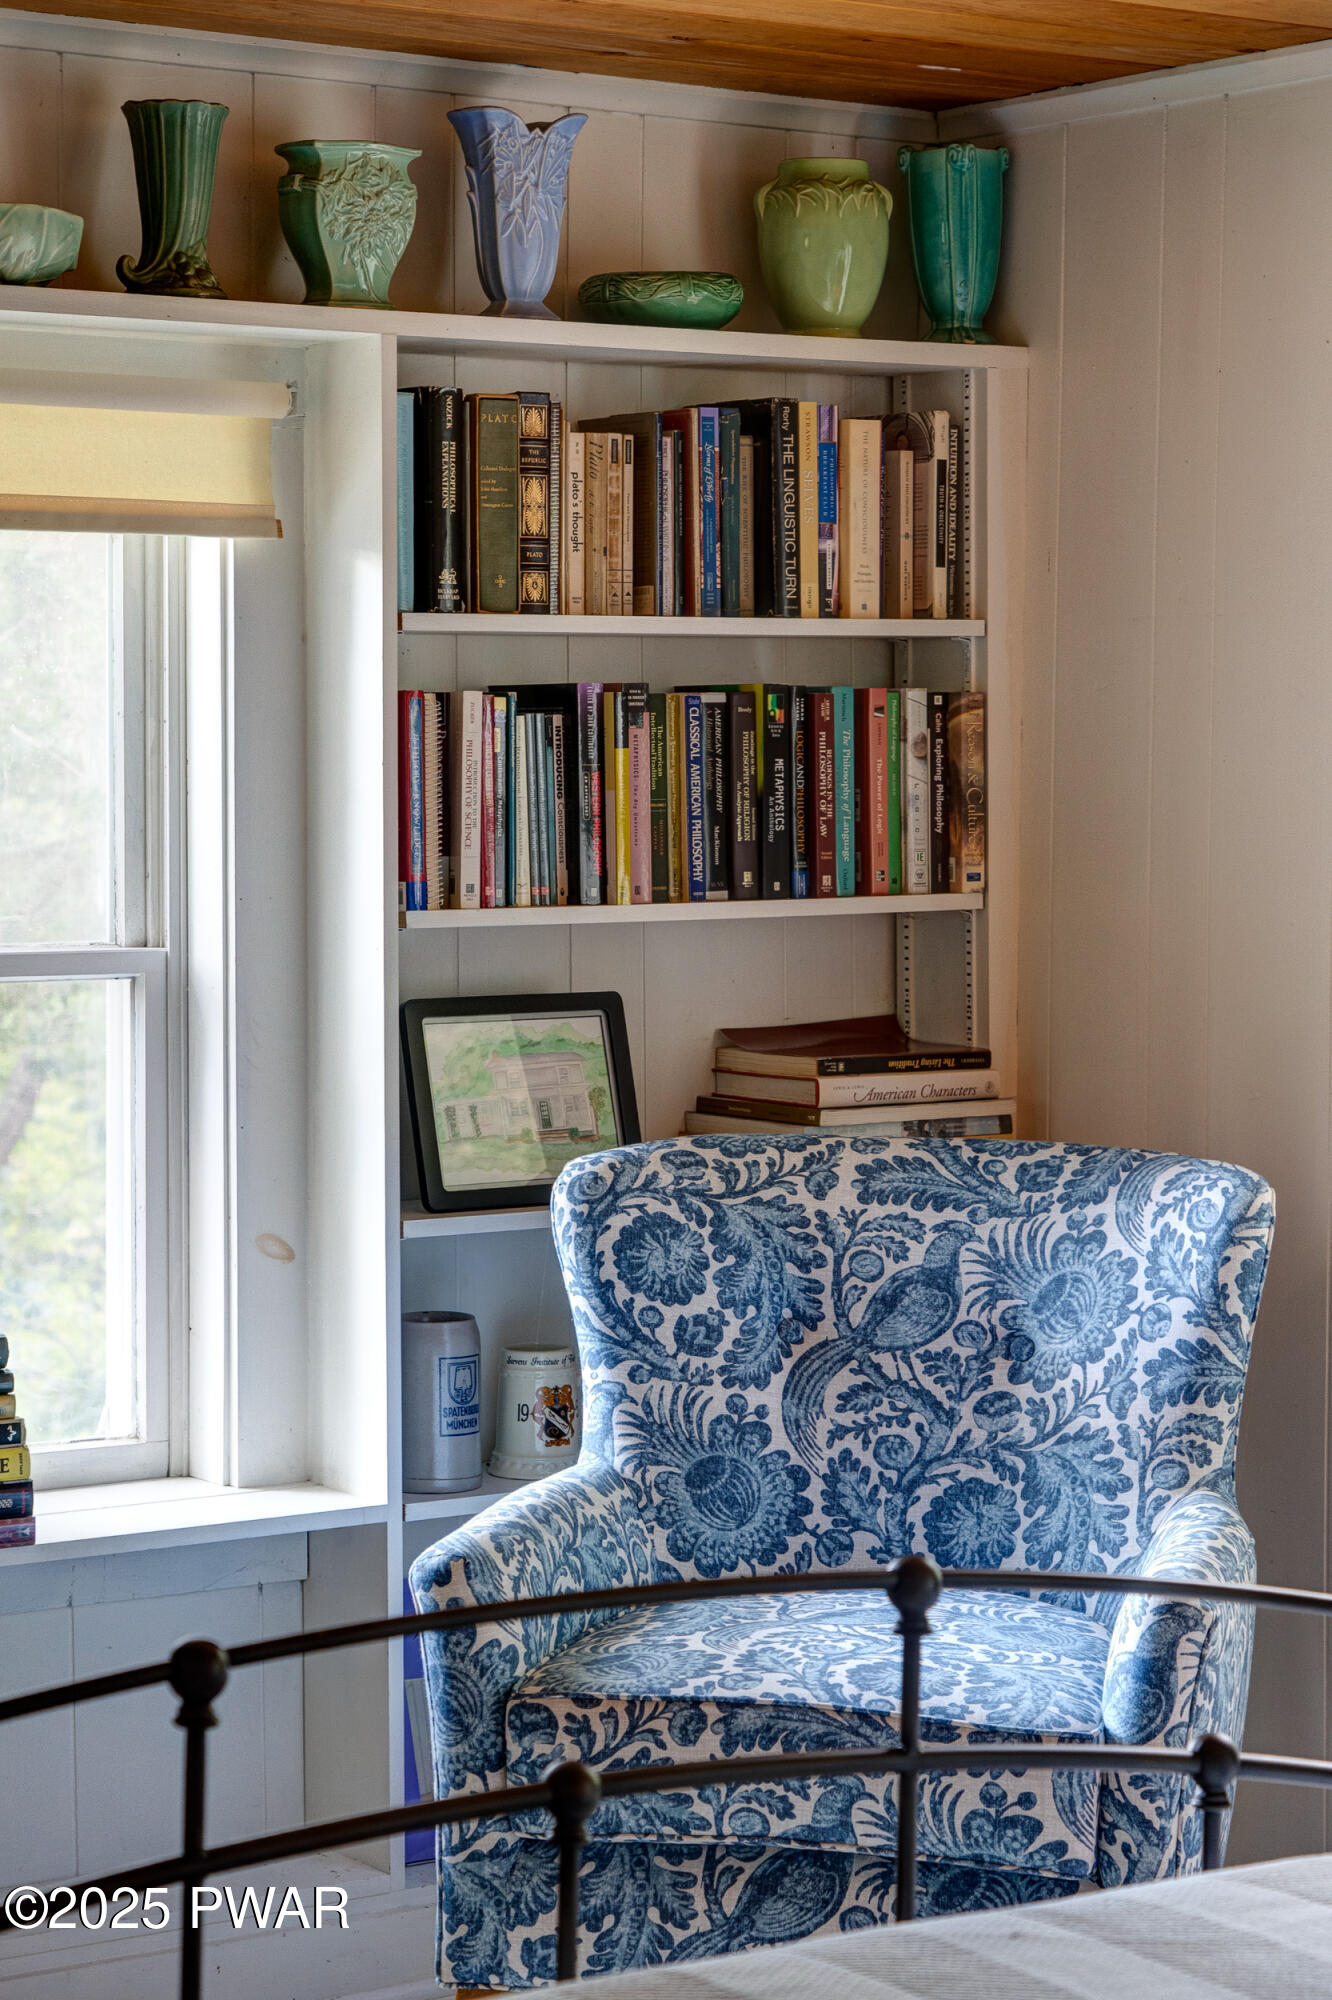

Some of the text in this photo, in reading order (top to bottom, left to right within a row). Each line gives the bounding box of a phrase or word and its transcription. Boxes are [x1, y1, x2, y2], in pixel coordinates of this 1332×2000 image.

[444, 395, 454, 429] NOZICK
[441, 440, 450, 509] EXPLANATIONS
[588, 440, 604, 480] Plato
[704, 442, 714, 467] Norms
[704, 466, 714, 474] of
[449, 440, 458, 515] PHILOSOPHICAL
[704, 476, 714, 503] Liberty
[804, 470, 815, 525] SELVES
[862, 479, 869, 489] OF
[948, 428, 958, 561] INTUITION AND IDEALITY
[570, 472, 583, 553] plato's thought
[742, 494, 749, 504] OF
[781, 406, 797, 599] Rorty THE LINGUISTIC TURN
[861, 491, 869, 555] CONSCIOUSNESS
[937, 510, 945, 544] OBJECTIVITY
[742, 552, 750, 598] PHILOSOPHY
[650, 712, 658, 791] Intellectual Tradition
[842, 729, 852, 747] The
[889, 736, 897, 762] Language
[706, 756, 714, 790] Anthology
[715, 757, 724, 813] PHILOSOPHY
[736, 781, 743, 790] An
[743, 731, 751, 841] PHILOSOPHY OF RELIGION
[818, 731, 828, 837] PHILOSOPHY OF LAW
[840, 749, 852, 801] Philosophy
[933, 712, 944, 833] Cahn Exploring Philosophy
[965, 721, 984, 845] Reason & Culture
[464, 739, 473, 850] PHILOSOPHY OF SCIENCE
[472, 807, 479, 816] TO
[496, 756, 504, 837] Contemporary Metaphysics
[555, 725, 566, 864] INTRODUCING Consciousness
[689, 707, 703, 882] CLASSICAL AMERICAN PHILOSOPHY
[774, 758, 785, 831] METAPHYSICS
[826, 790, 833, 799] IN
[840, 803, 852, 814] of
[876, 803, 883, 812] of
[412, 793, 421, 858] KNOWLEDGE
[591, 771, 602, 876] WESTERN PHILOSOPHY
[735, 814, 743, 842] Approach
[767, 796, 776, 843] An Anthology
[840, 815, 852, 862] Language
[875, 813, 883, 835] Logic
[888, 1059, 920, 1071] Tradition
[920, 1057, 942, 1070] Living
[942, 1056, 956, 1068] The
[853, 1083, 977, 1103] American Characters
[562, 1354, 568, 1368] of
[446, 1417, 478, 1430] MÜNCHEN
[517, 1404, 530, 1422] 19
